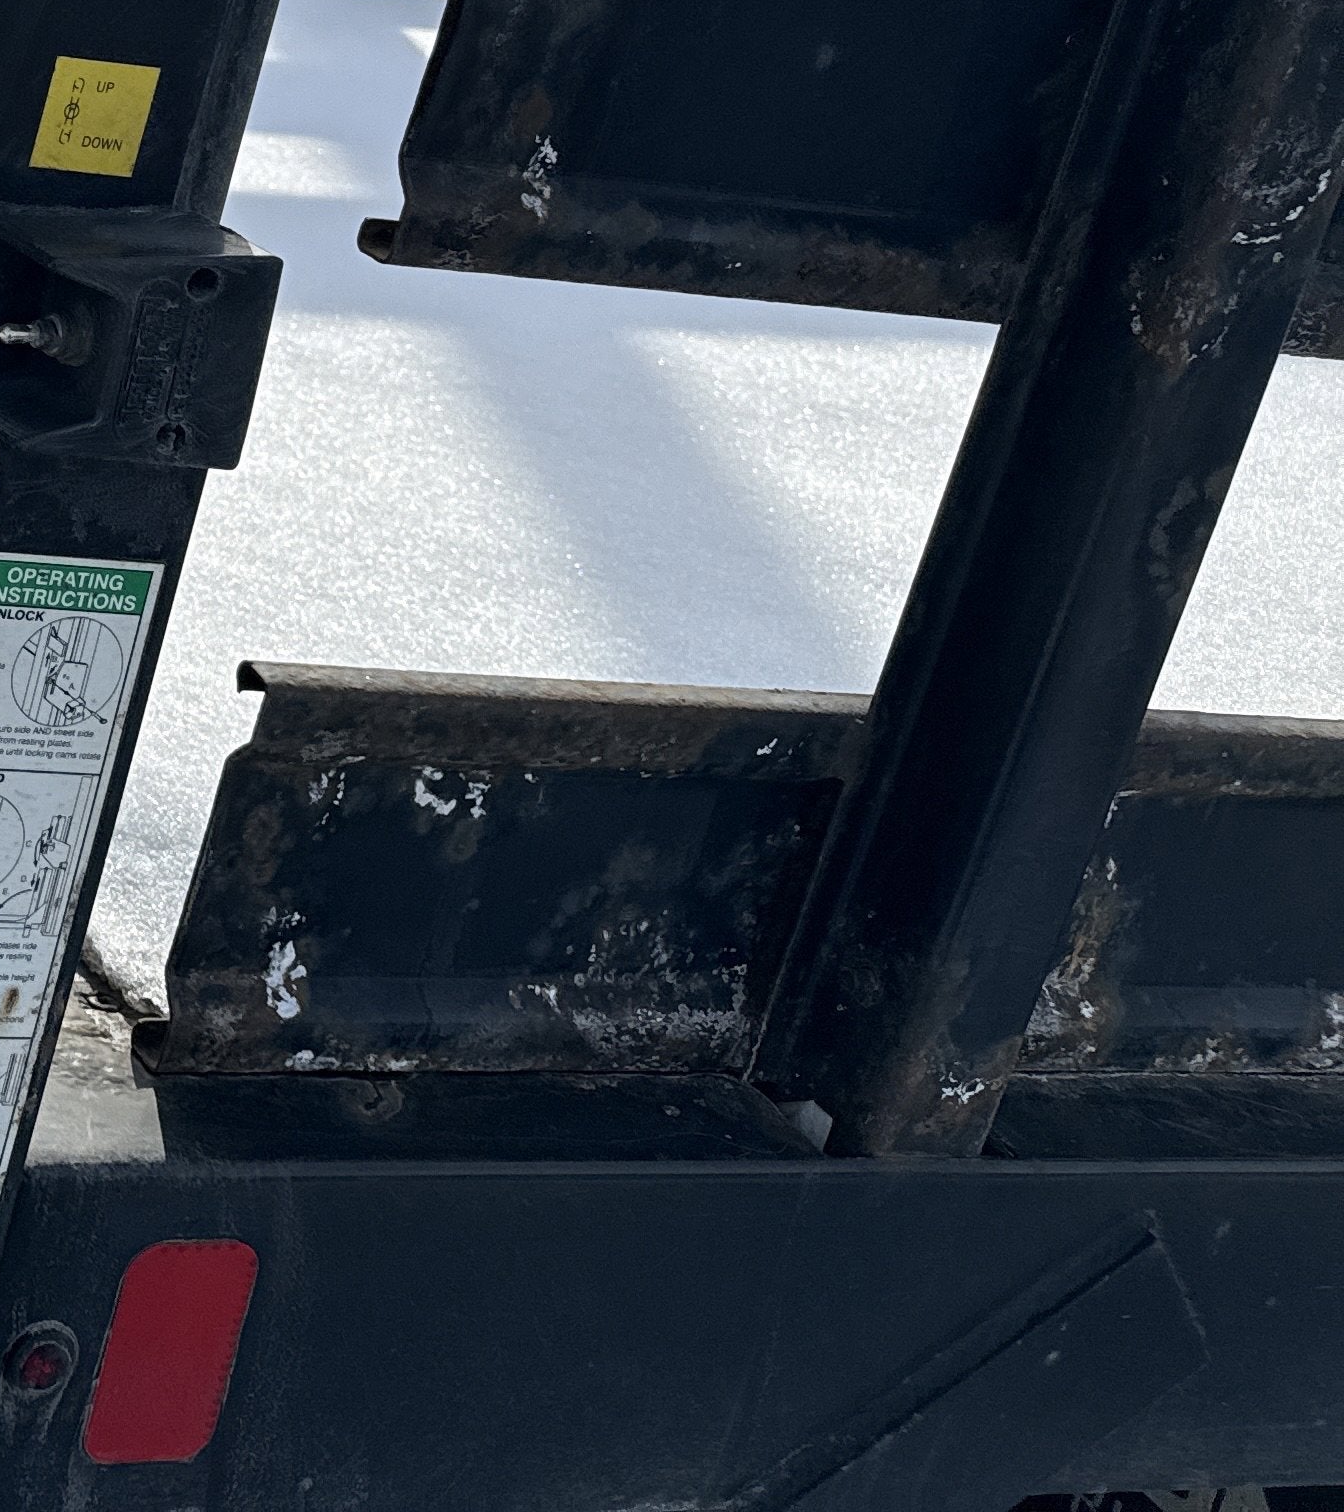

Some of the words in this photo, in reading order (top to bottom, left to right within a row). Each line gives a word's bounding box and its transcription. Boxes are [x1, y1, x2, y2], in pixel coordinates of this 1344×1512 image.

[95, 80, 115, 93] UP
[80, 135, 123, 151] DOWN
[6, 566, 124, 591] OPERATING
